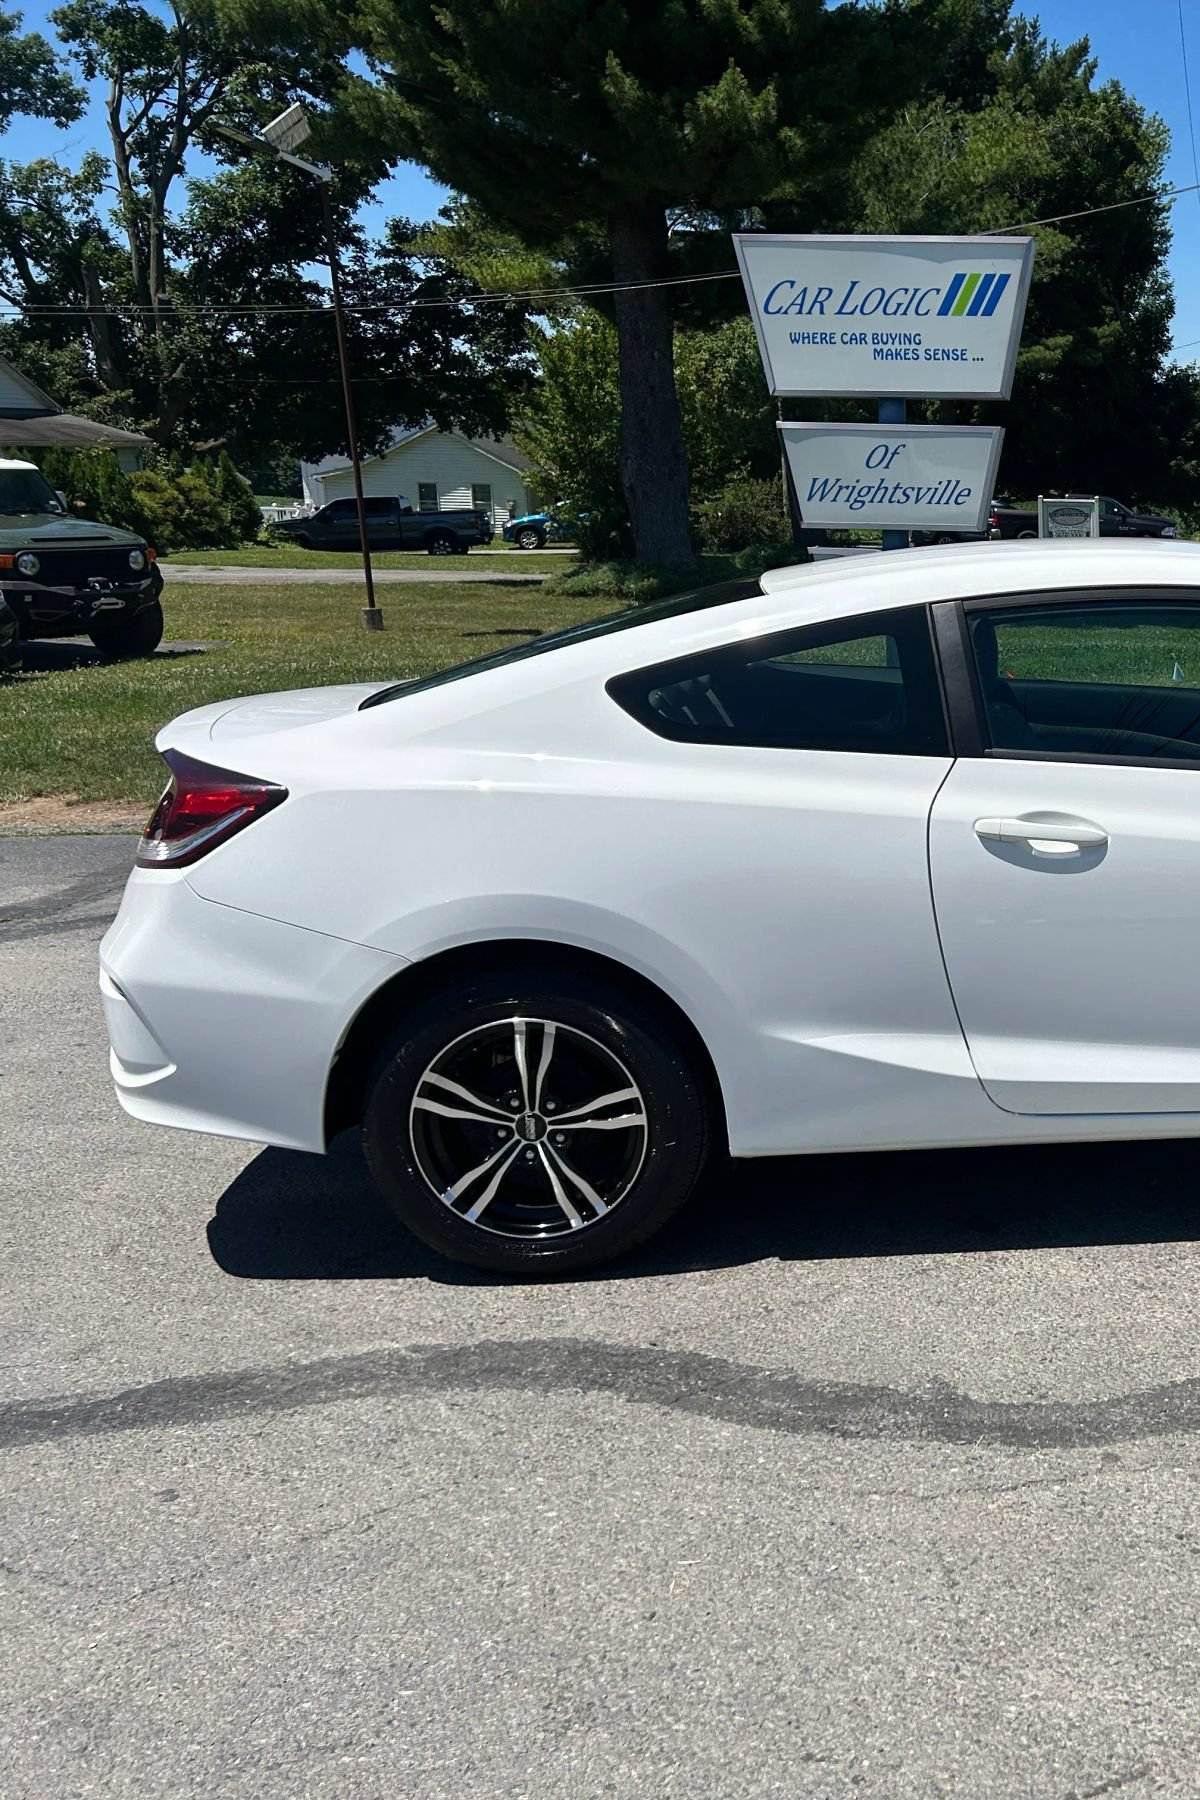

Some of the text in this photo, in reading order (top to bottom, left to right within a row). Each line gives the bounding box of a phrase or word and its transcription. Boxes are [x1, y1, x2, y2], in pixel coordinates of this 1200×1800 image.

[763, 280, 941, 316] CAR LOGIC
[789, 332, 922, 345] WHERE CAR BUYING
[873, 348, 920, 361] MAKES
[924, 348, 968, 361] SENSE
[865, 444, 907, 470] Of
[807, 478, 972, 511] Wrightsville
